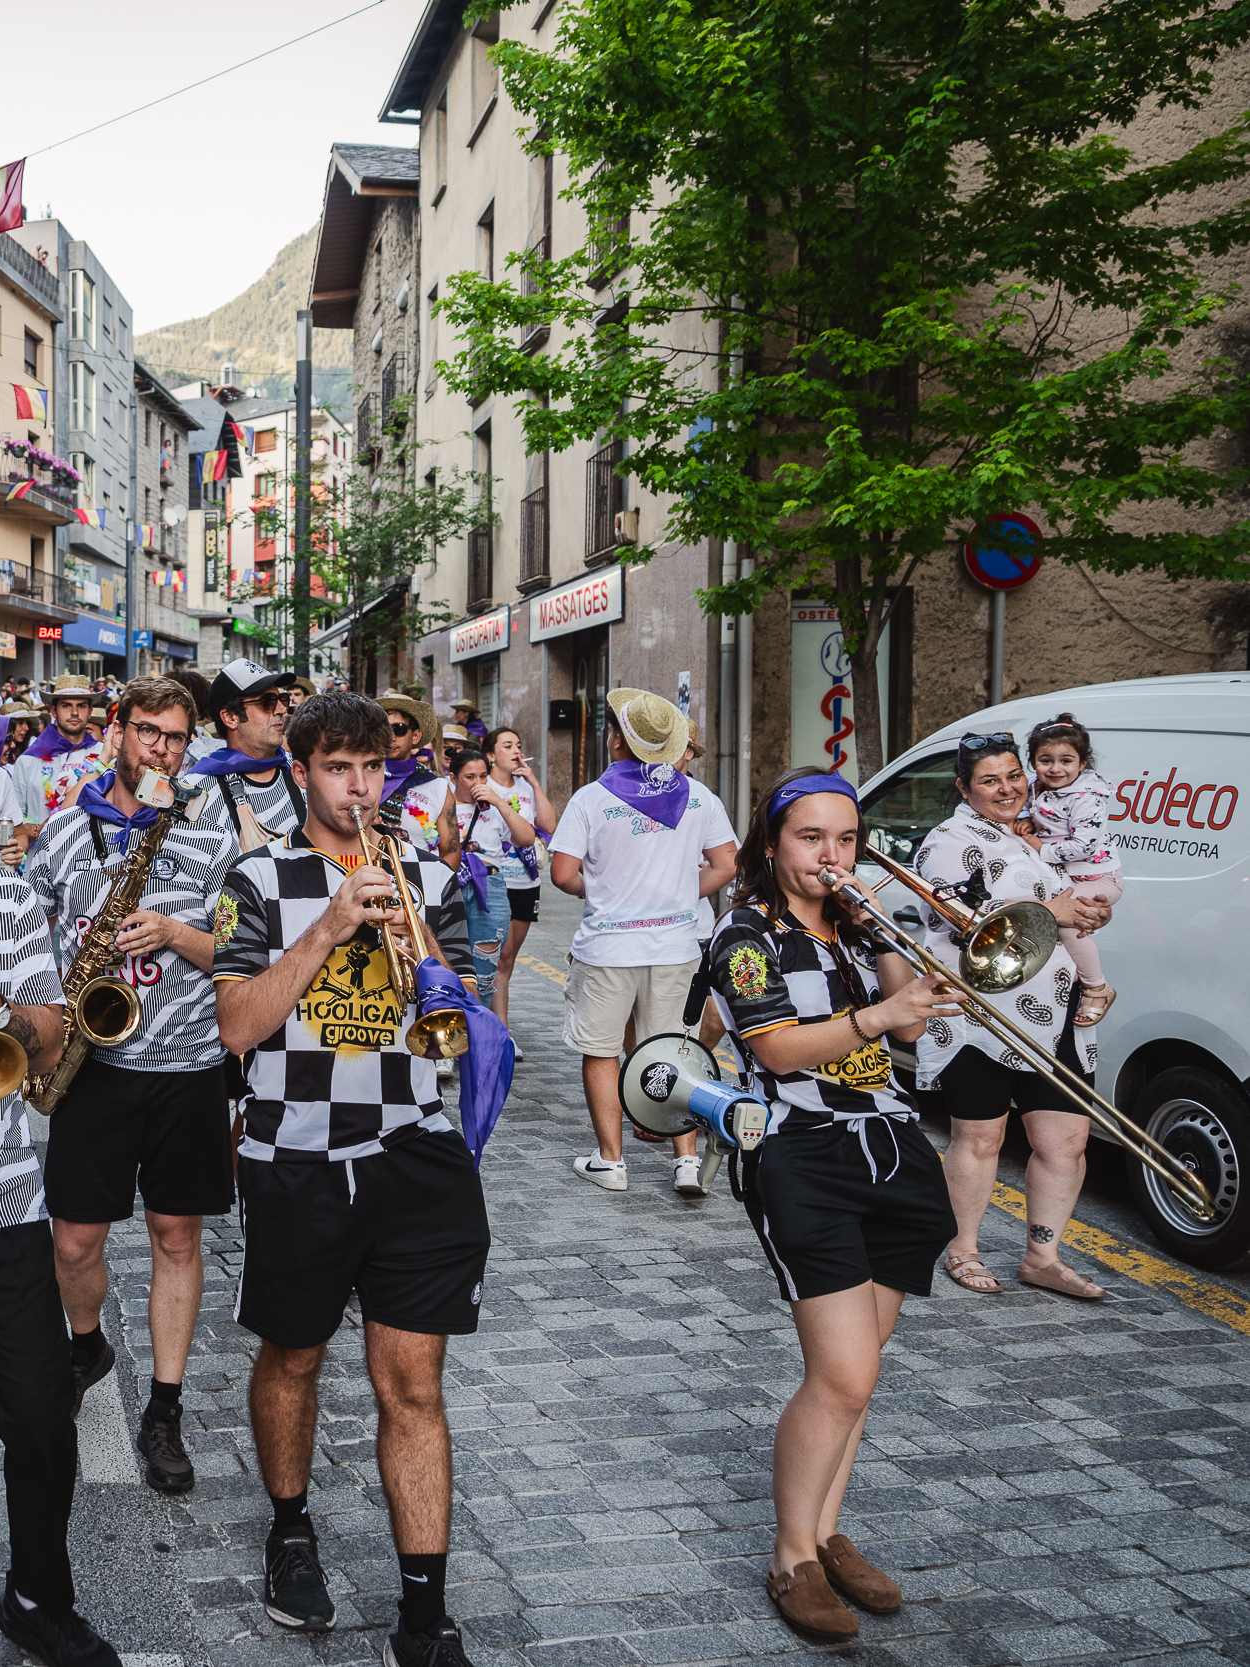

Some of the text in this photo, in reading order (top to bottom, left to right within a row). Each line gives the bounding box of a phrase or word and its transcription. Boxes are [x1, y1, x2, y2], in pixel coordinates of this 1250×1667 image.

[539, 580, 609, 630] MASSATGES
[455, 619, 501, 653] OSTEOPATIA
[1108, 767, 1239, 831] sideco
[631, 817, 672, 835] 202
[1111, 833, 1219, 859] ONSTRUCTORA
[325, 1025, 393, 1046] groove
